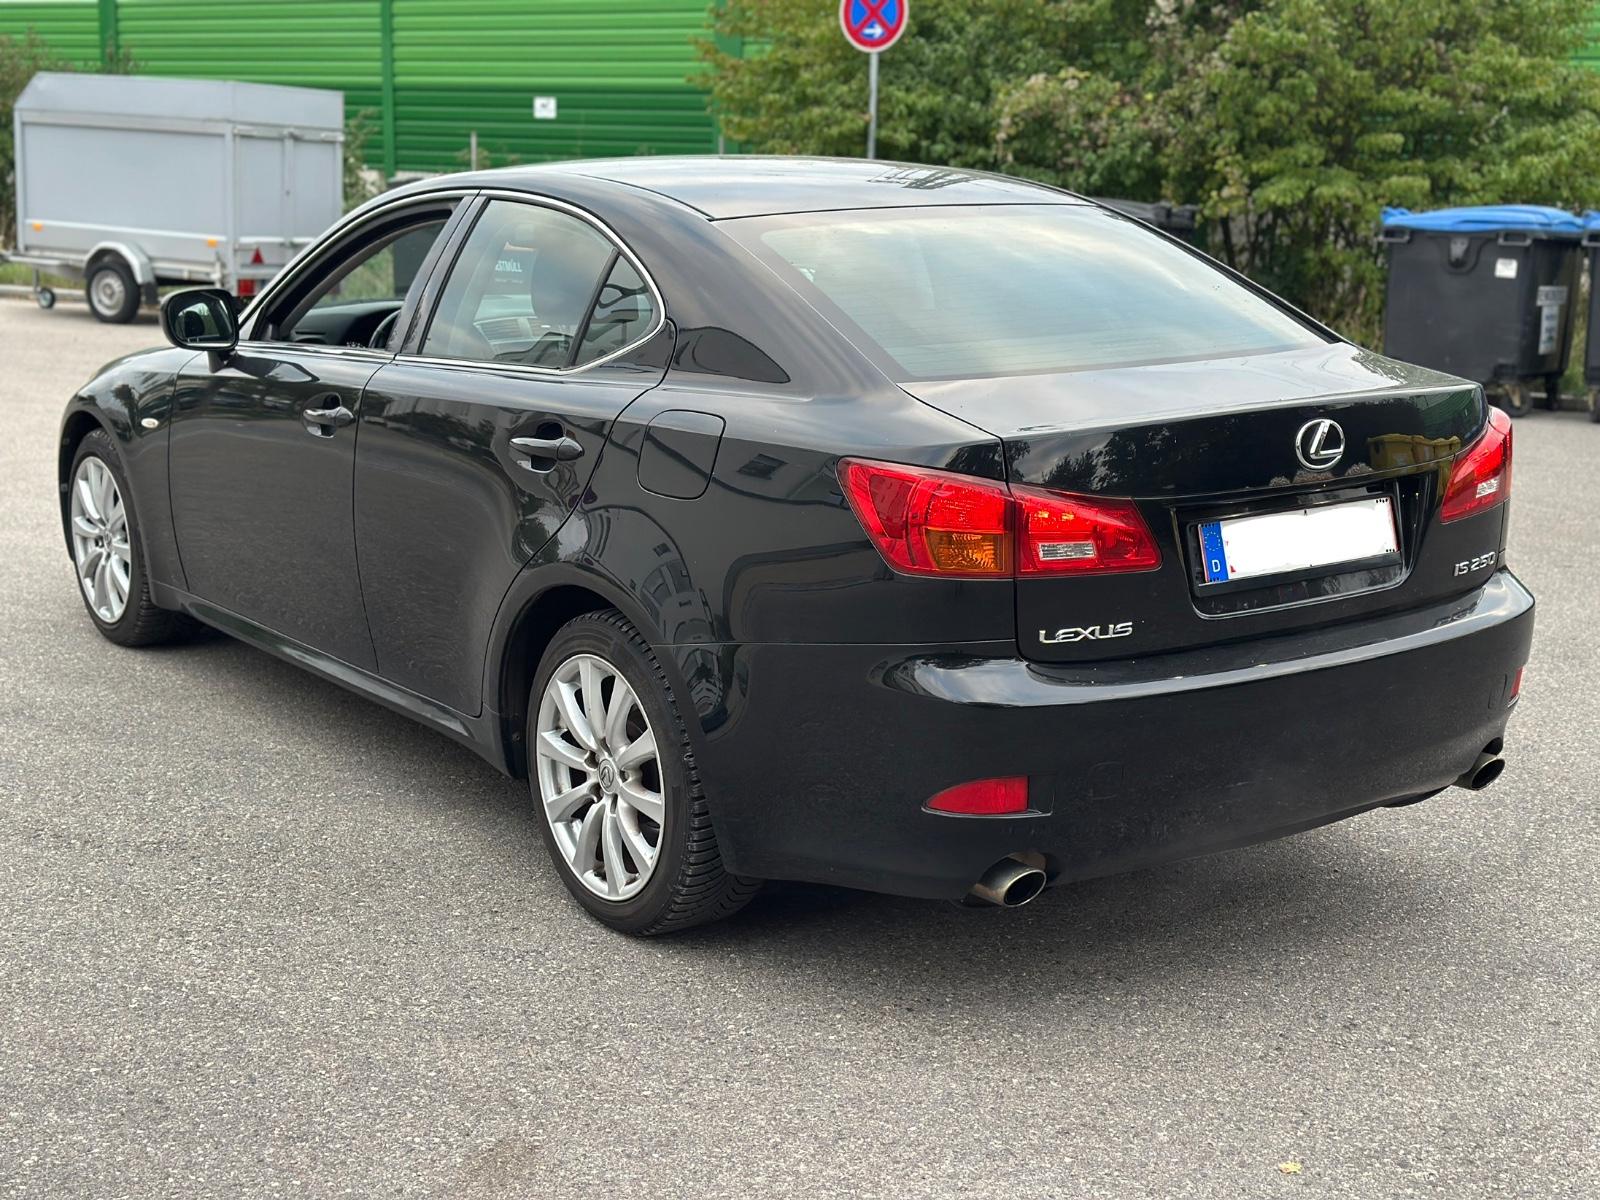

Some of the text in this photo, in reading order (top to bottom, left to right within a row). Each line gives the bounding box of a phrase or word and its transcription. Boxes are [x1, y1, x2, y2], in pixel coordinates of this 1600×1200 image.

[1211, 559, 1221, 573] D
[1453, 551, 1496, 577] IS 250
[1039, 621, 1133, 643] LEXUS
